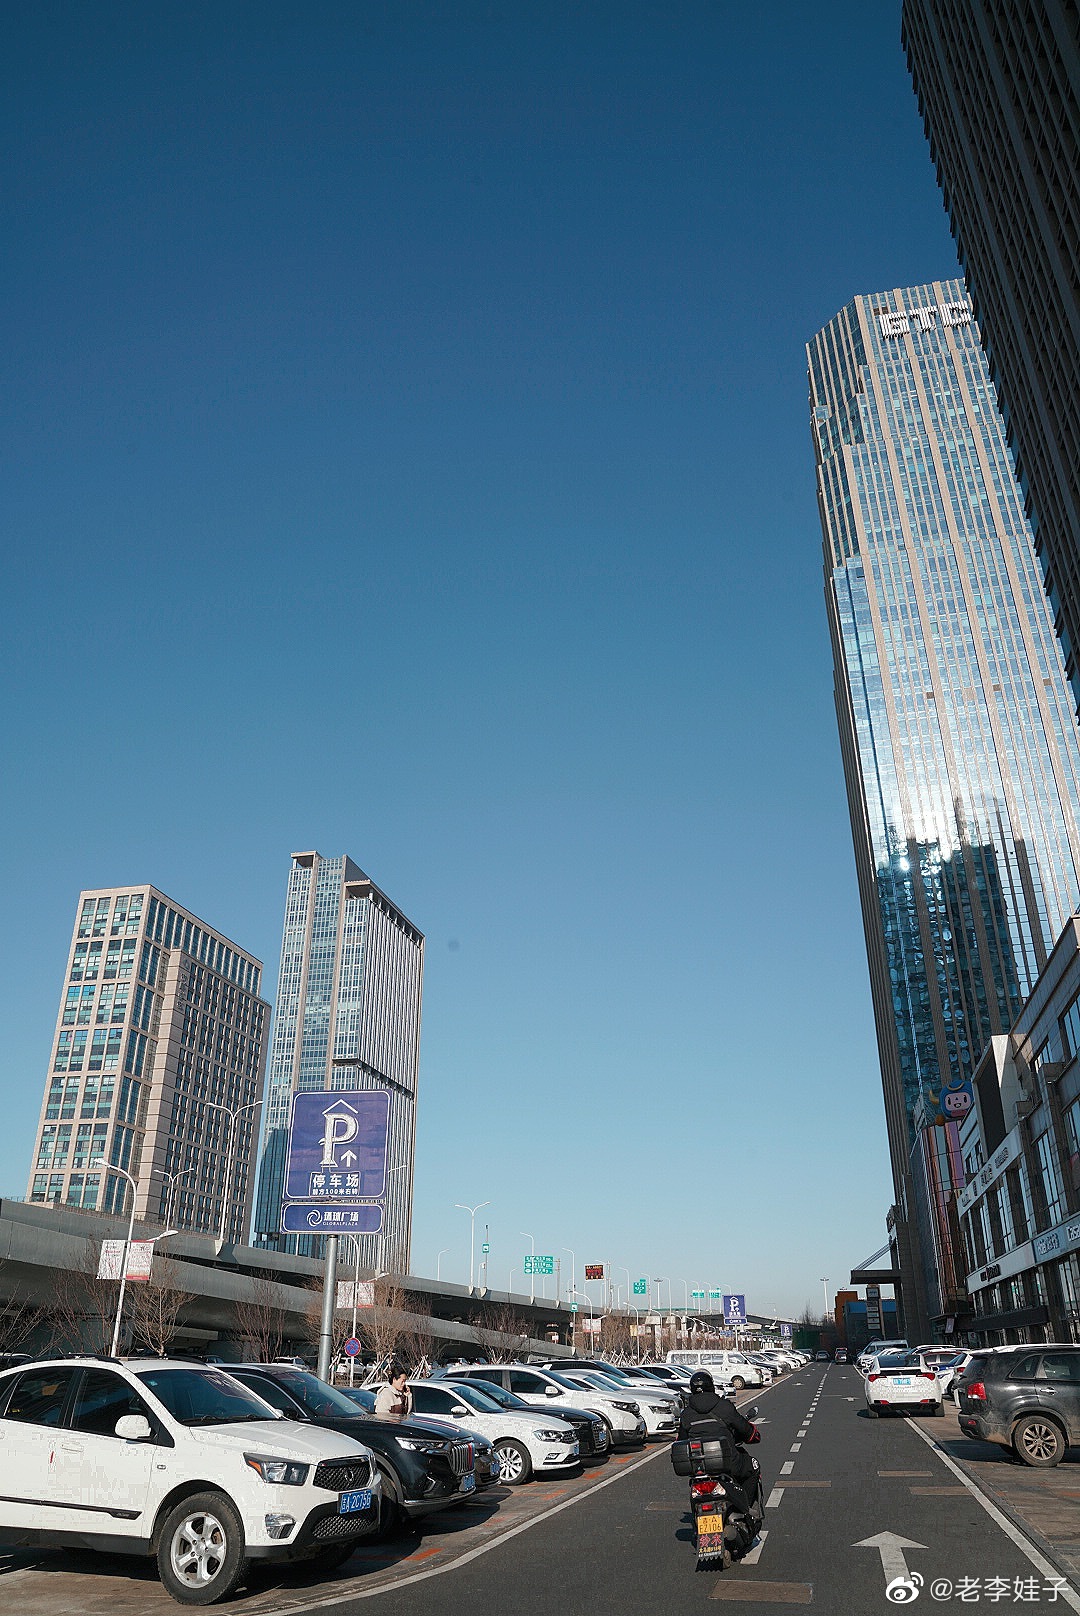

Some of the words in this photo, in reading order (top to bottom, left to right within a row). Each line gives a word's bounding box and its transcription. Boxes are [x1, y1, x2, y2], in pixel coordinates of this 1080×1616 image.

[318, 1113, 359, 1168] P
[312, 1174, 359, 1188] 停车场
[312, 1188, 358, 1196] 前方100米右转
[323, 1211, 359, 1222] 环球广场
